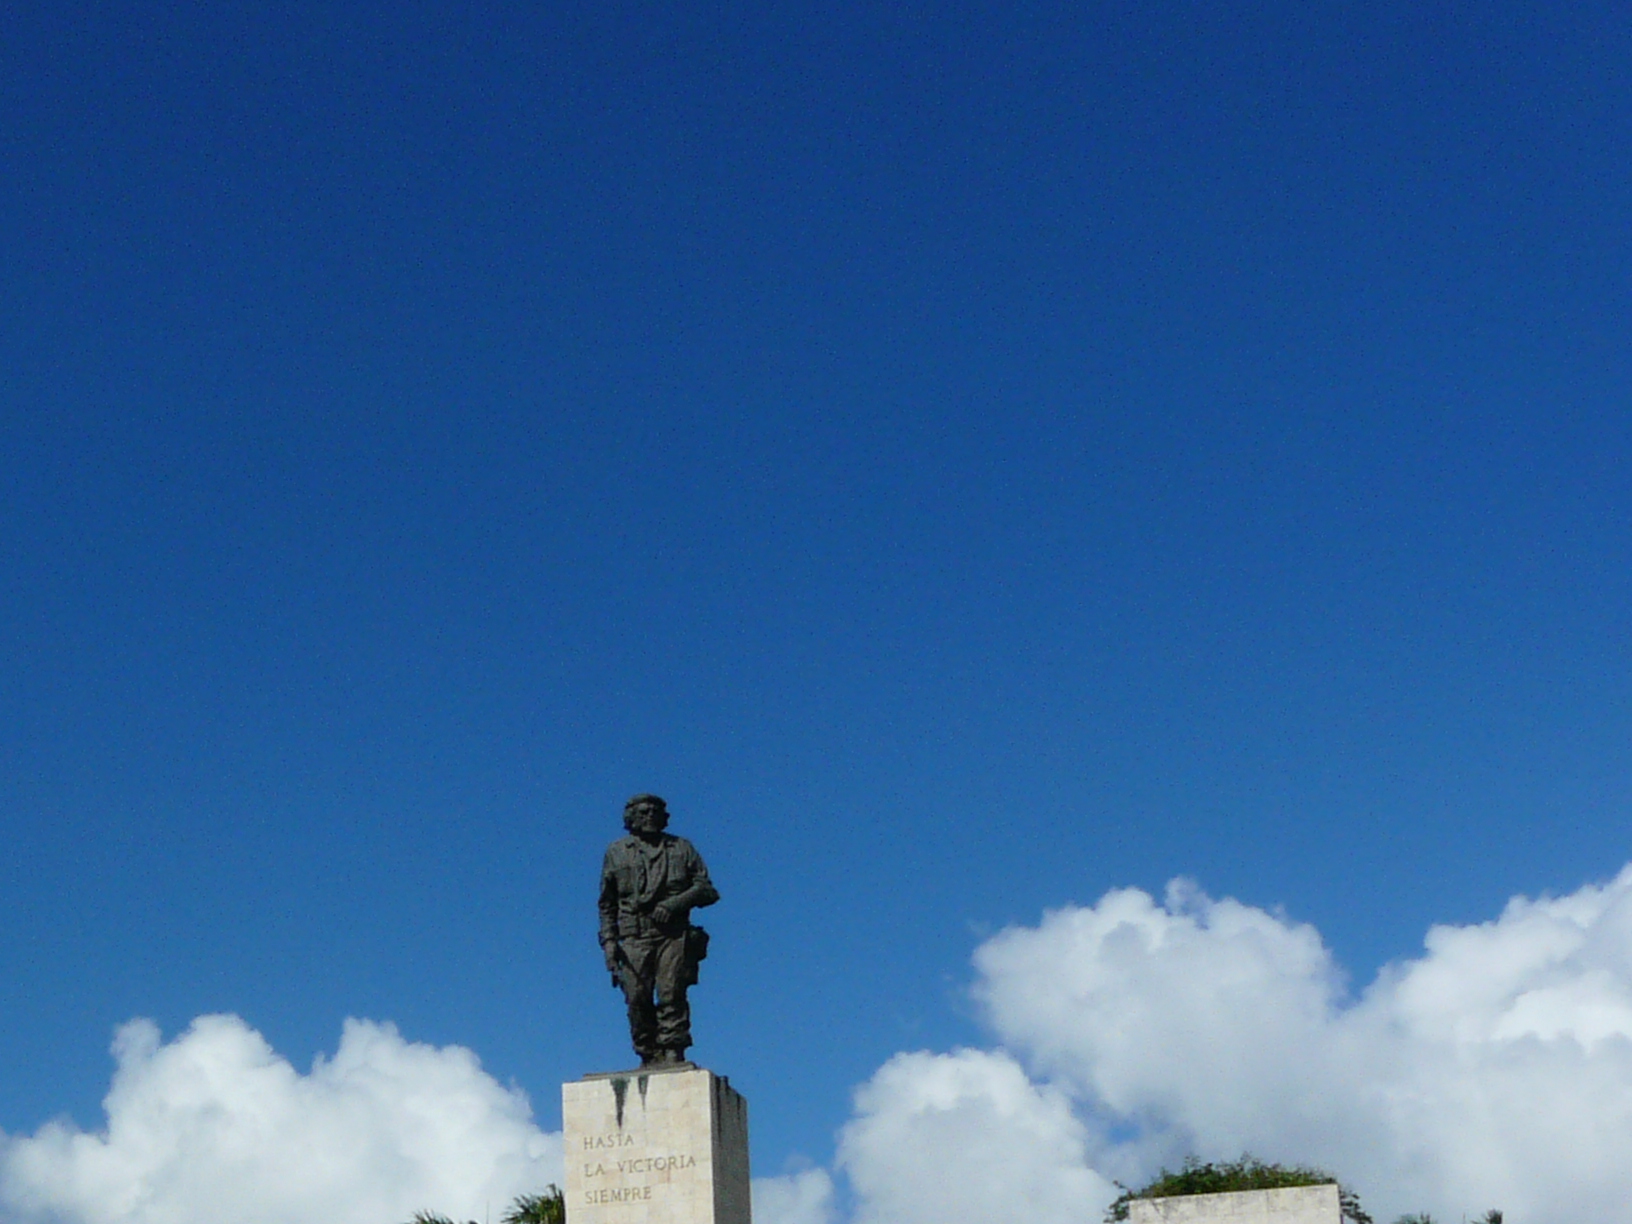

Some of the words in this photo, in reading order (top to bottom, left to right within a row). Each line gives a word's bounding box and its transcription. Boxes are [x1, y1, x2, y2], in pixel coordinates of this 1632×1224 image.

[583, 1133, 634, 1150] HASTA
[584, 1162, 605, 1178] LA
[617, 1155, 696, 1173] VICTORIA
[585, 1186, 651, 1204] SIEMPRE
